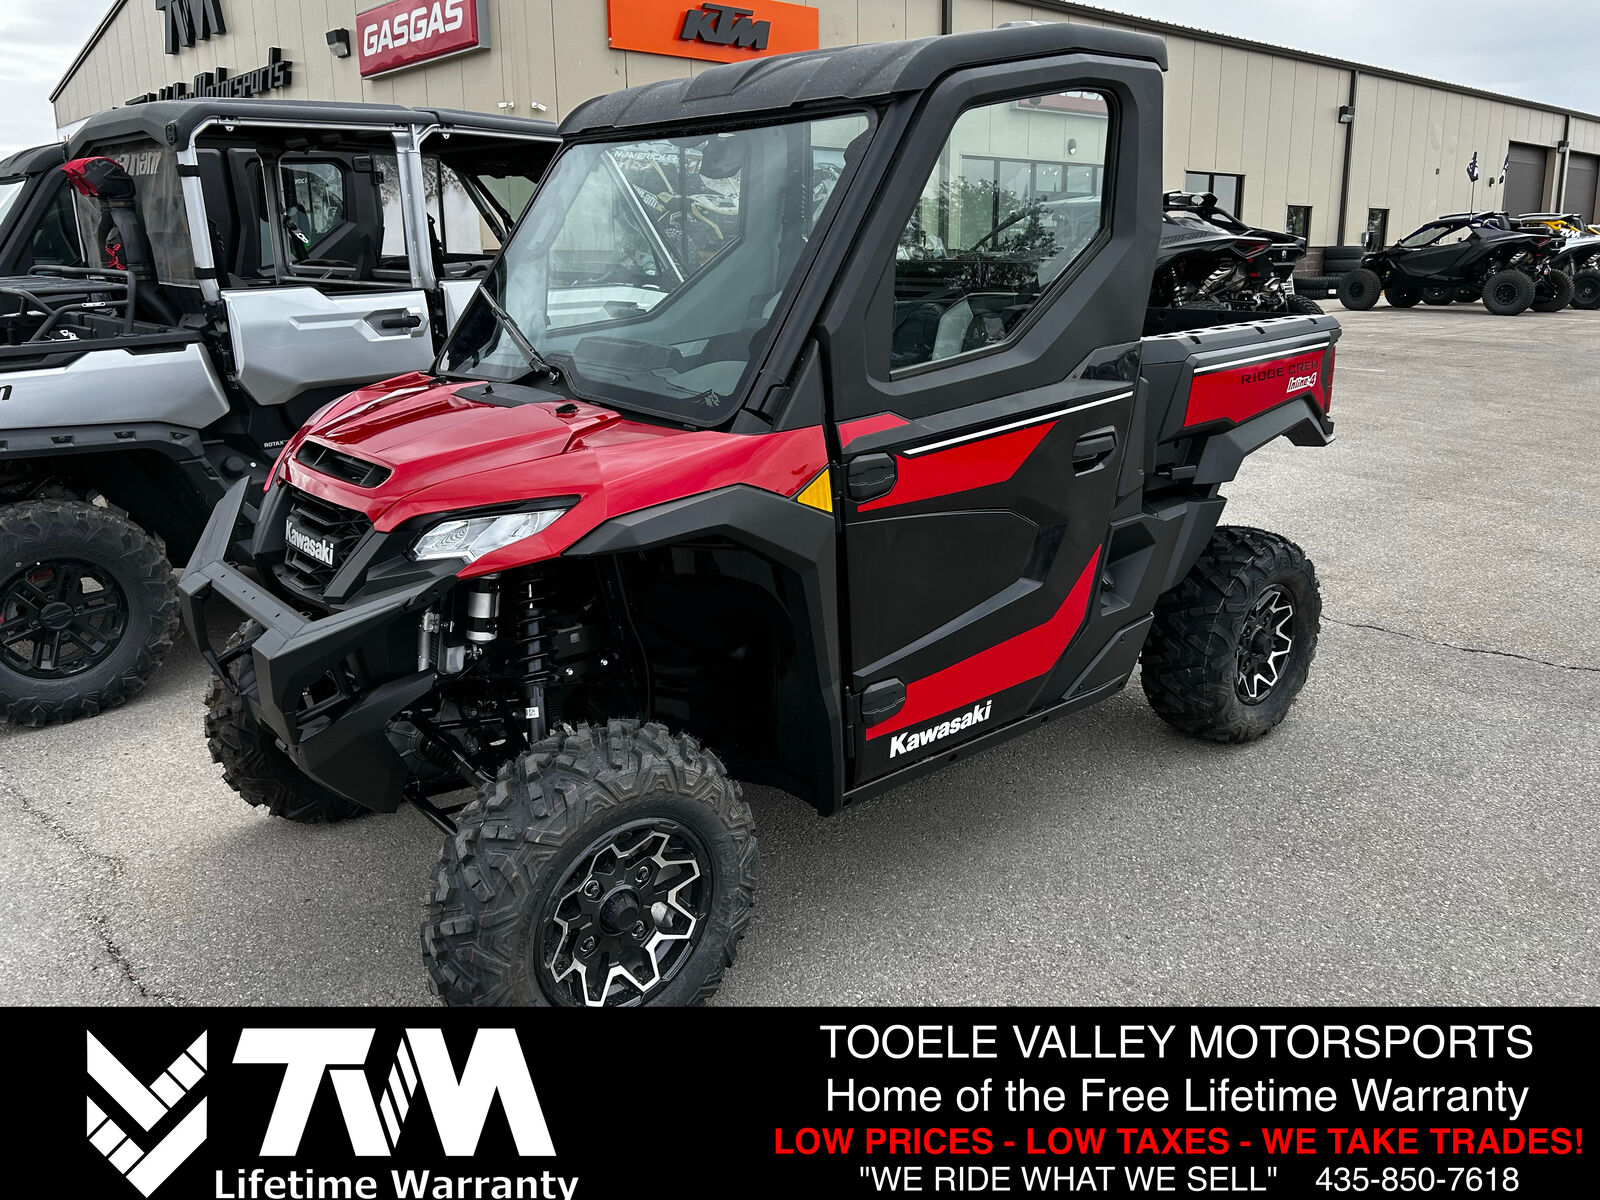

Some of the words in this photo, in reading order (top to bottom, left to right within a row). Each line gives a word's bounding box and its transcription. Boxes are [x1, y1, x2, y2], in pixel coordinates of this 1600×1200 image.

[363, 0, 464, 57] GASGAS
[679, 2, 771, 50] KTM
[1241, 367, 1285, 385] RIDGE
[1288, 359, 1319, 375] CREW
[263, 440, 285, 448] ROTAX
[285, 519, 334, 566] Kawasaki
[889, 699, 993, 759] Kawasaki
